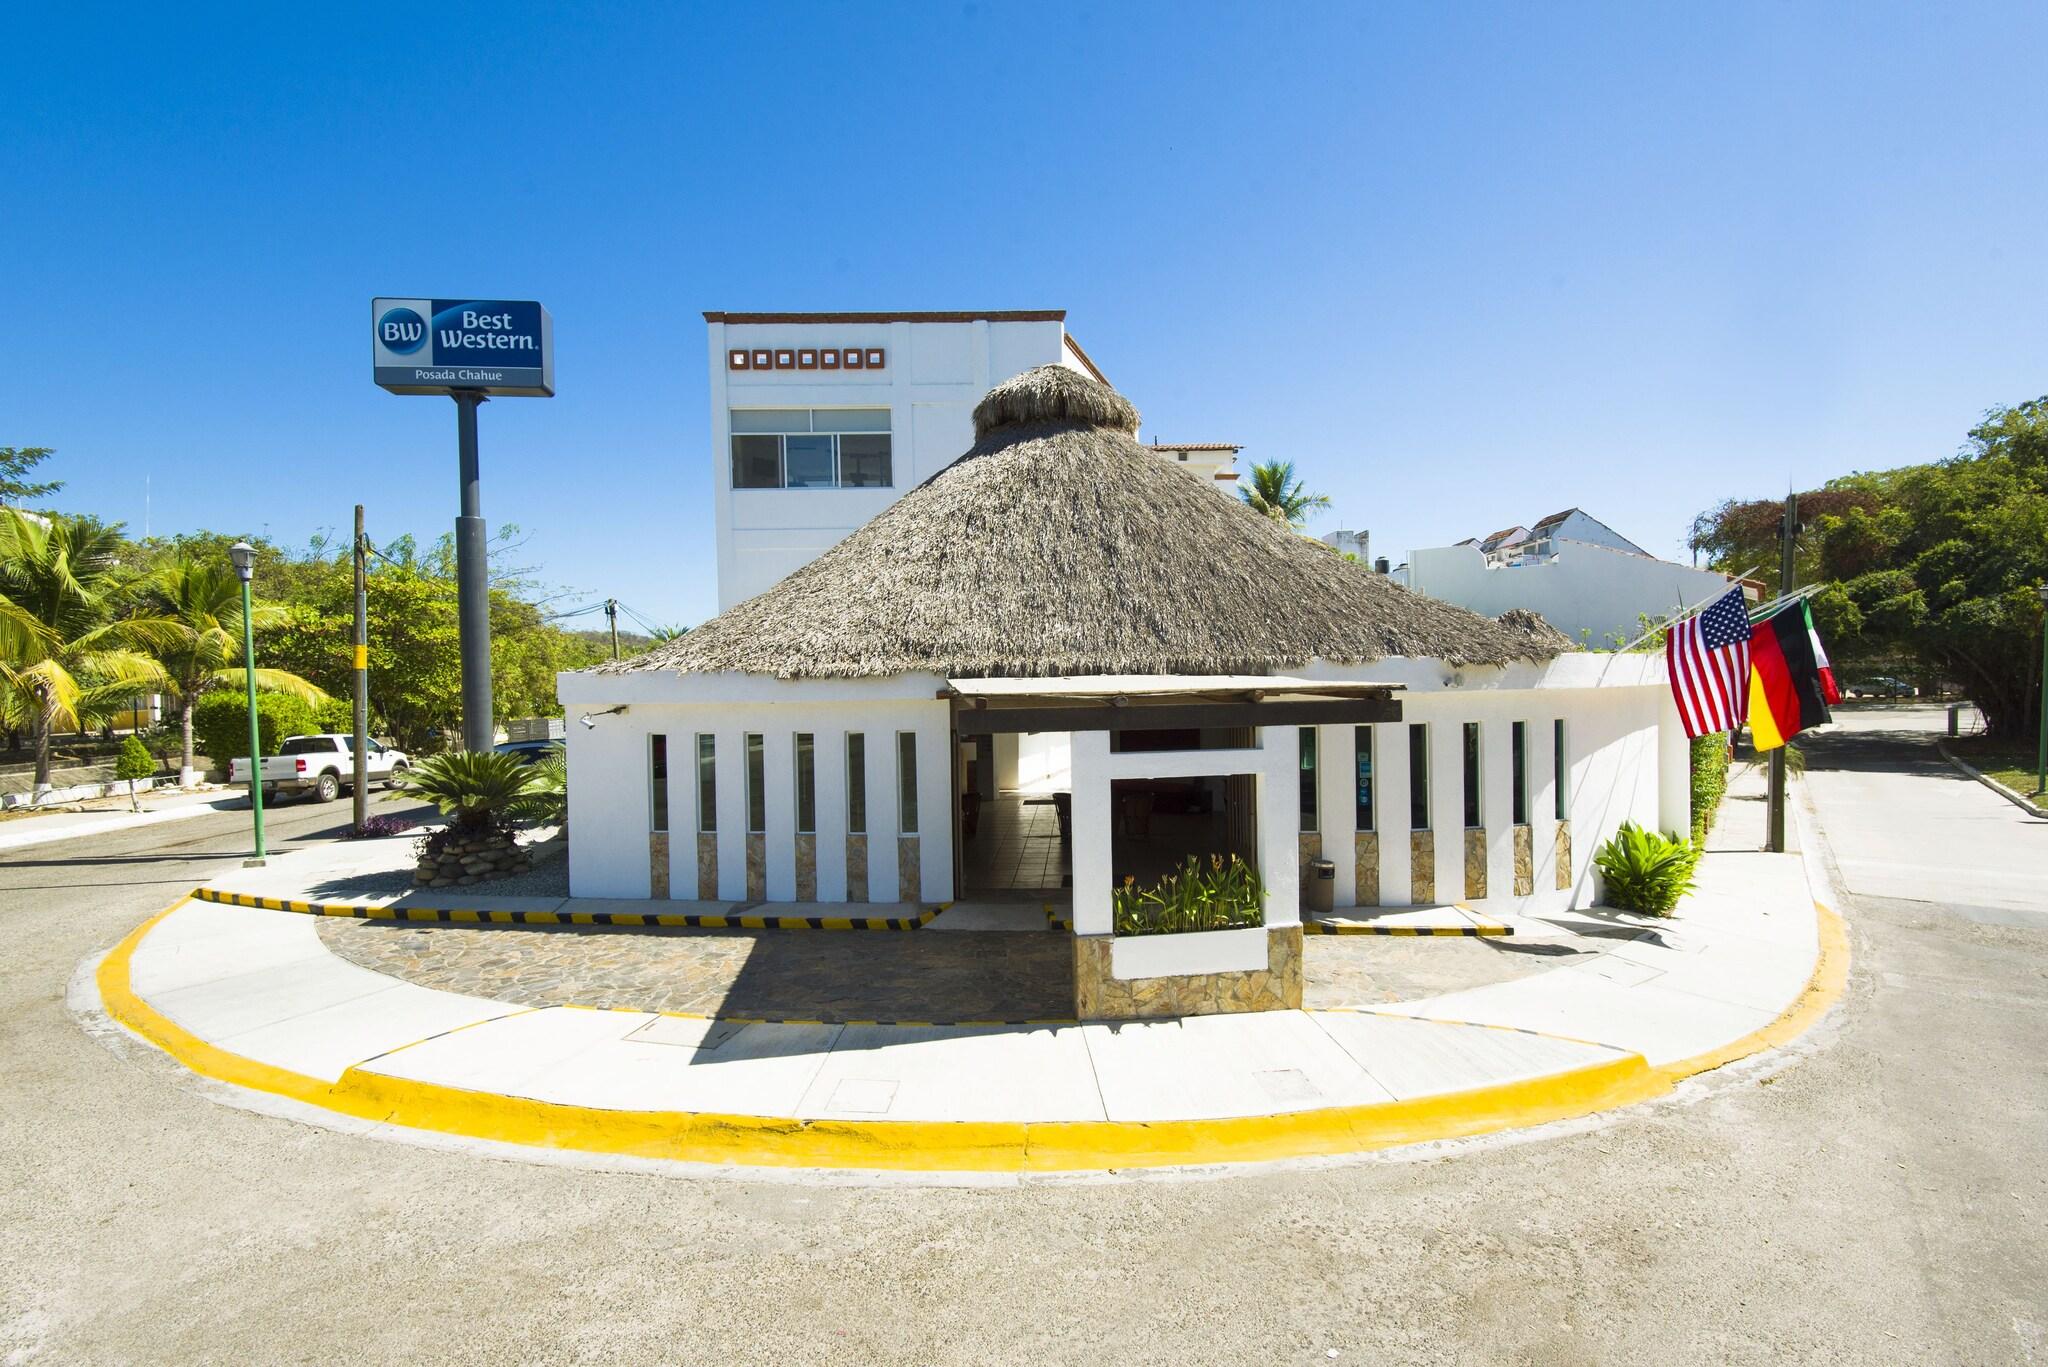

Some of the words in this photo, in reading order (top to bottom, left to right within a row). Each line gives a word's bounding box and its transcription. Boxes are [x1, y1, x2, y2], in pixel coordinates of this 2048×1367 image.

[462, 310, 513, 330] Best
[384, 322, 422, 342] BW
[415, 369, 456, 380] Posada
[458, 369, 503, 381] Chahue
